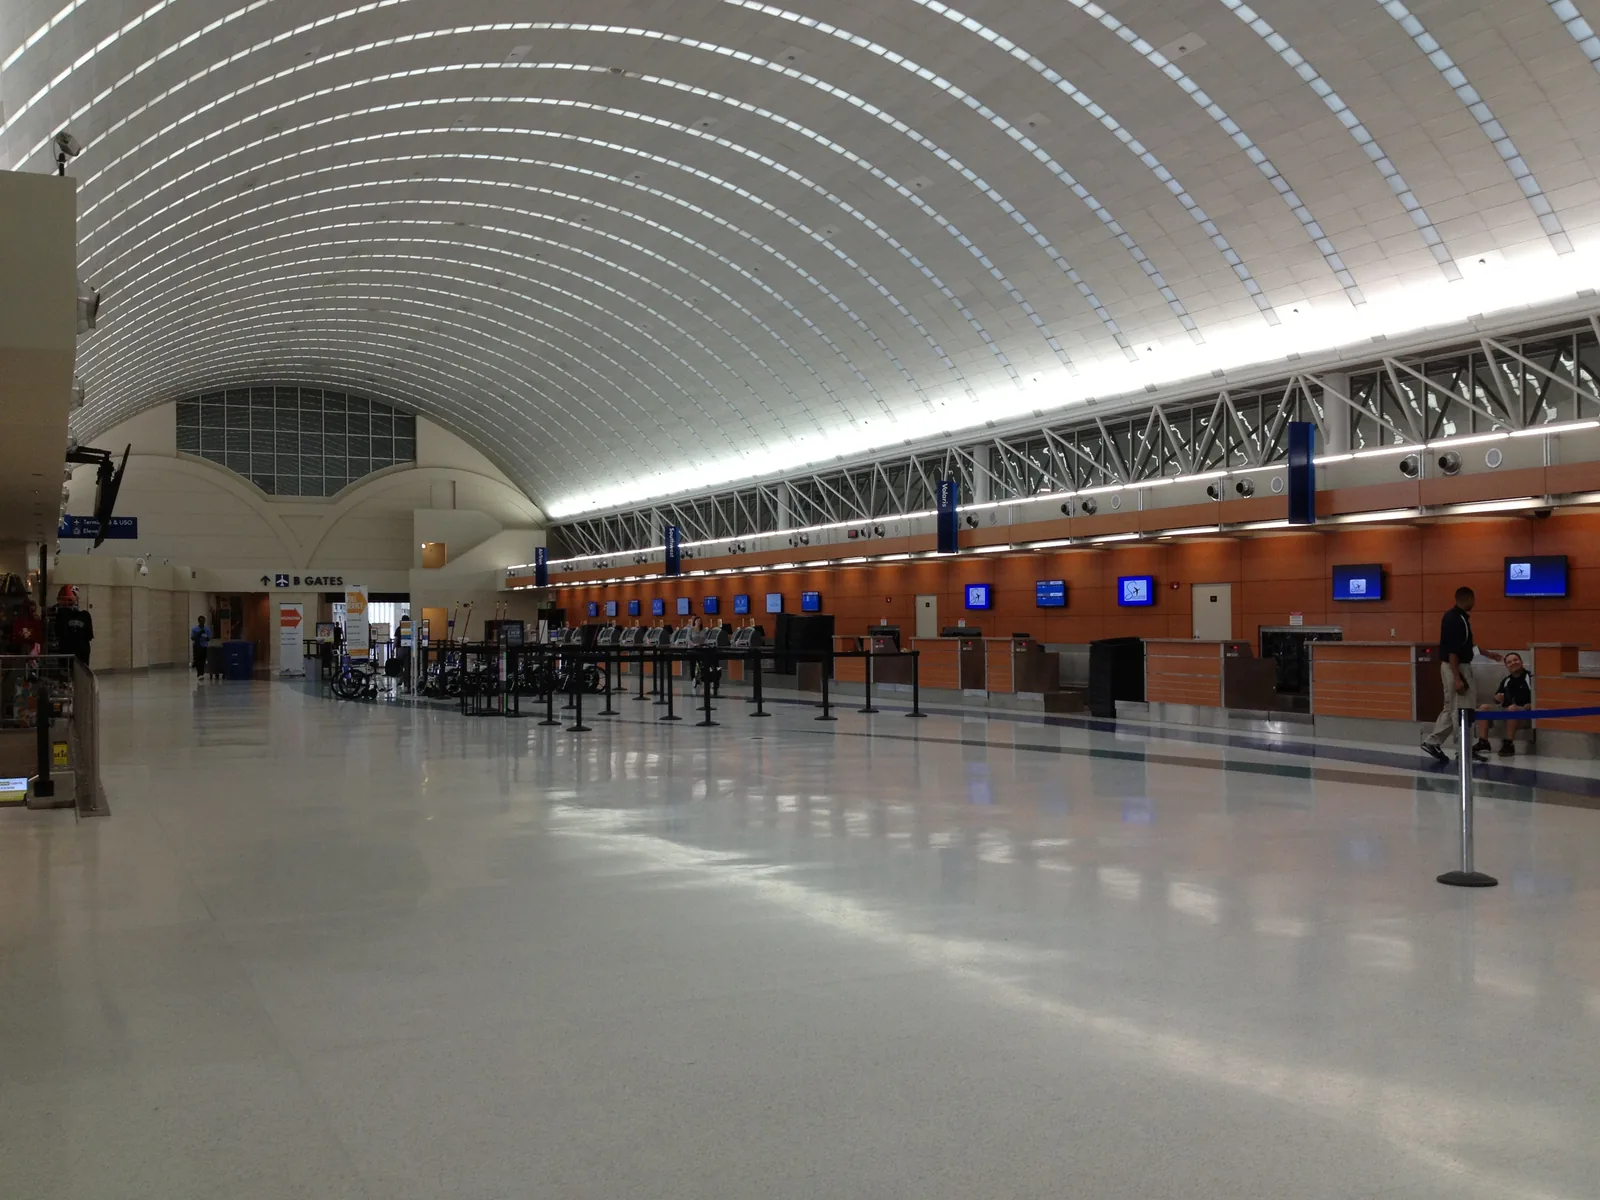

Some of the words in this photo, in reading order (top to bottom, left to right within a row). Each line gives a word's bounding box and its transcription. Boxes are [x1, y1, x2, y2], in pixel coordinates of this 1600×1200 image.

[941, 483, 949, 508] Volaris
[293, 576, 300, 586] B
[304, 576, 344, 586] GATES
